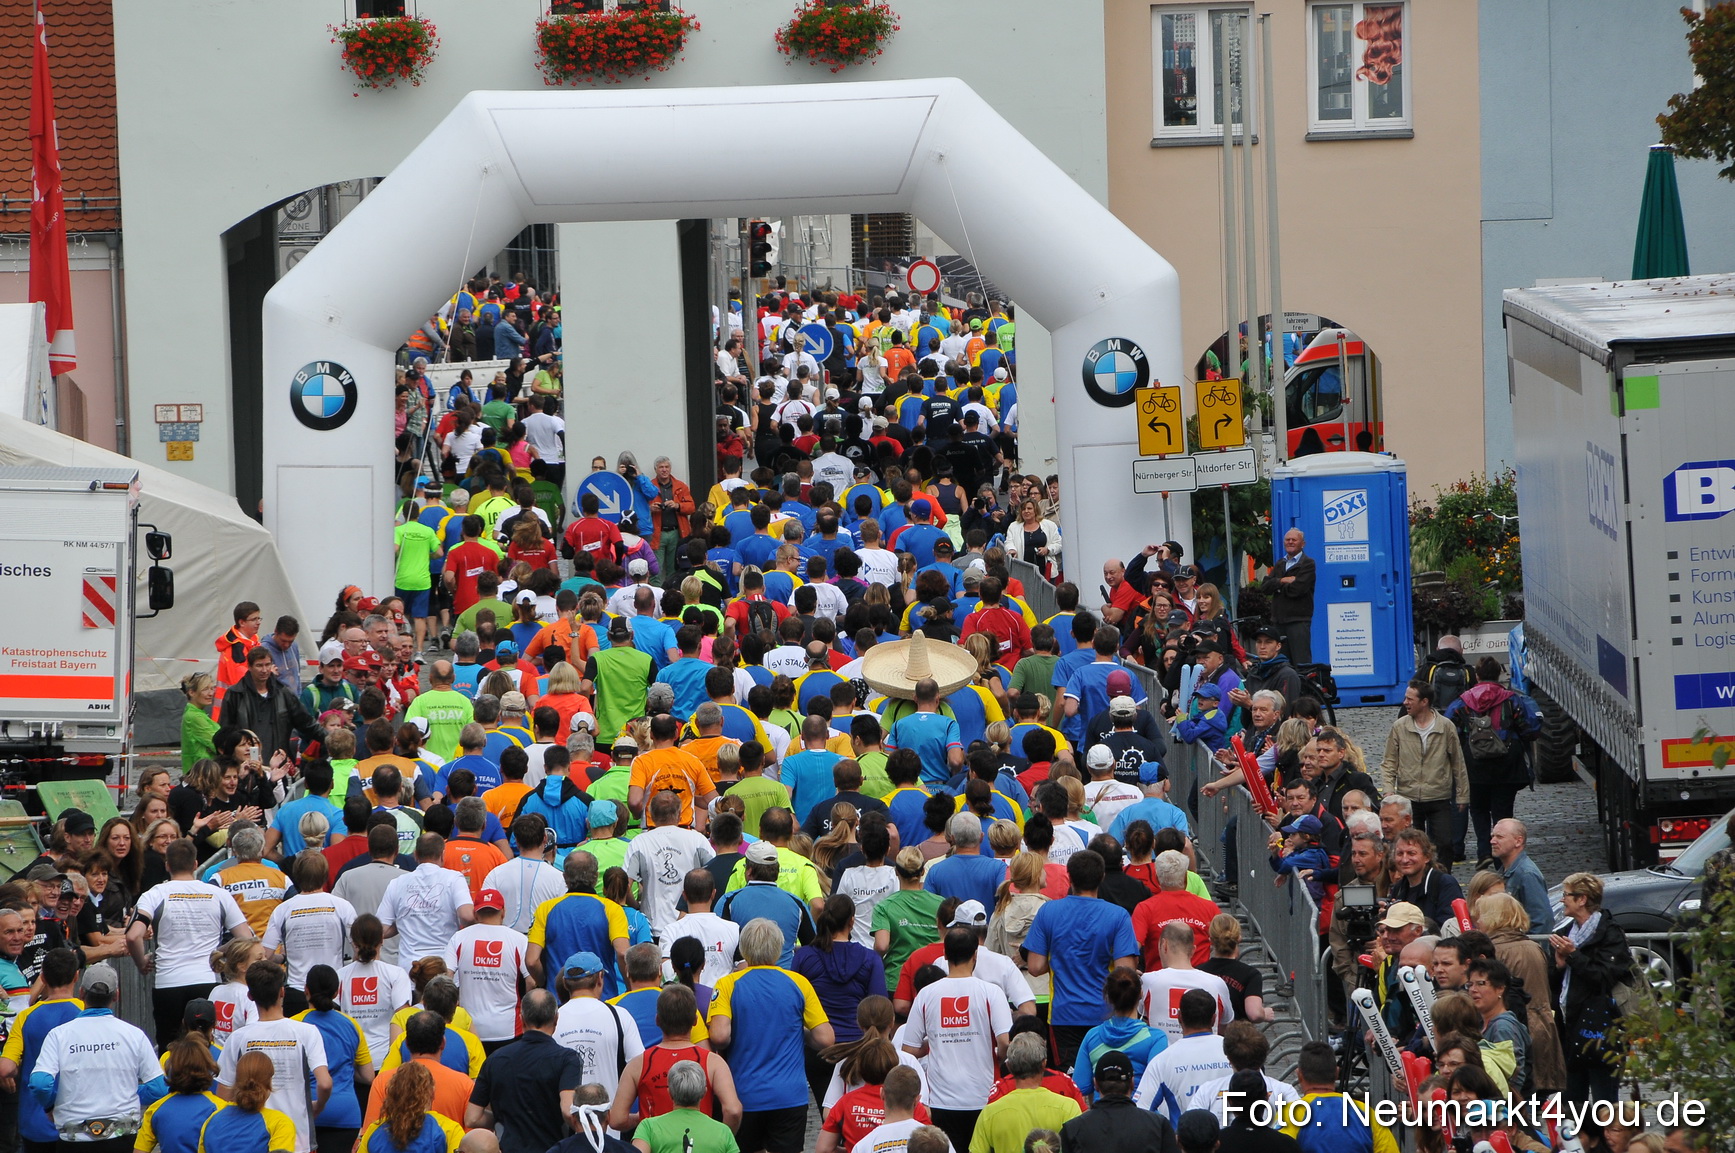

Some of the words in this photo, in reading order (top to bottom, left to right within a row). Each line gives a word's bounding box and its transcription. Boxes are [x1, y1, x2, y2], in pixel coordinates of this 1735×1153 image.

[287, 223, 310, 231] ZONE
[1087, 339, 1144, 364] BMW
[295, 362, 353, 385] BMW
[1197, 463, 1236, 474] Altdorfer
[1238, 461, 1255, 470] Str.
[1135, 471, 1179, 480] Nürnberger
[1181, 470, 1195, 478] Str.
[1, 647, 107, 659] Katastrophenschutz
[11, 659, 57, 669] Freistaat
[60, 660, 97, 671] Bayern
[771, 660, 782, 669] SV
[439, 710, 464, 720] DAV
[479, 776, 496, 784] TEAM
[225, 879, 265, 892] Benzin
[475, 957, 499, 965] DKMS
[353, 994, 376, 1003] DKMS
[943, 1015, 968, 1025] DKMS
[560, 1029, 578, 1038] Münch
[585, 1028, 603, 1036] Münch
[1175, 1065, 1189, 1074] TSV
[852, 1105, 865, 1113] Fit
